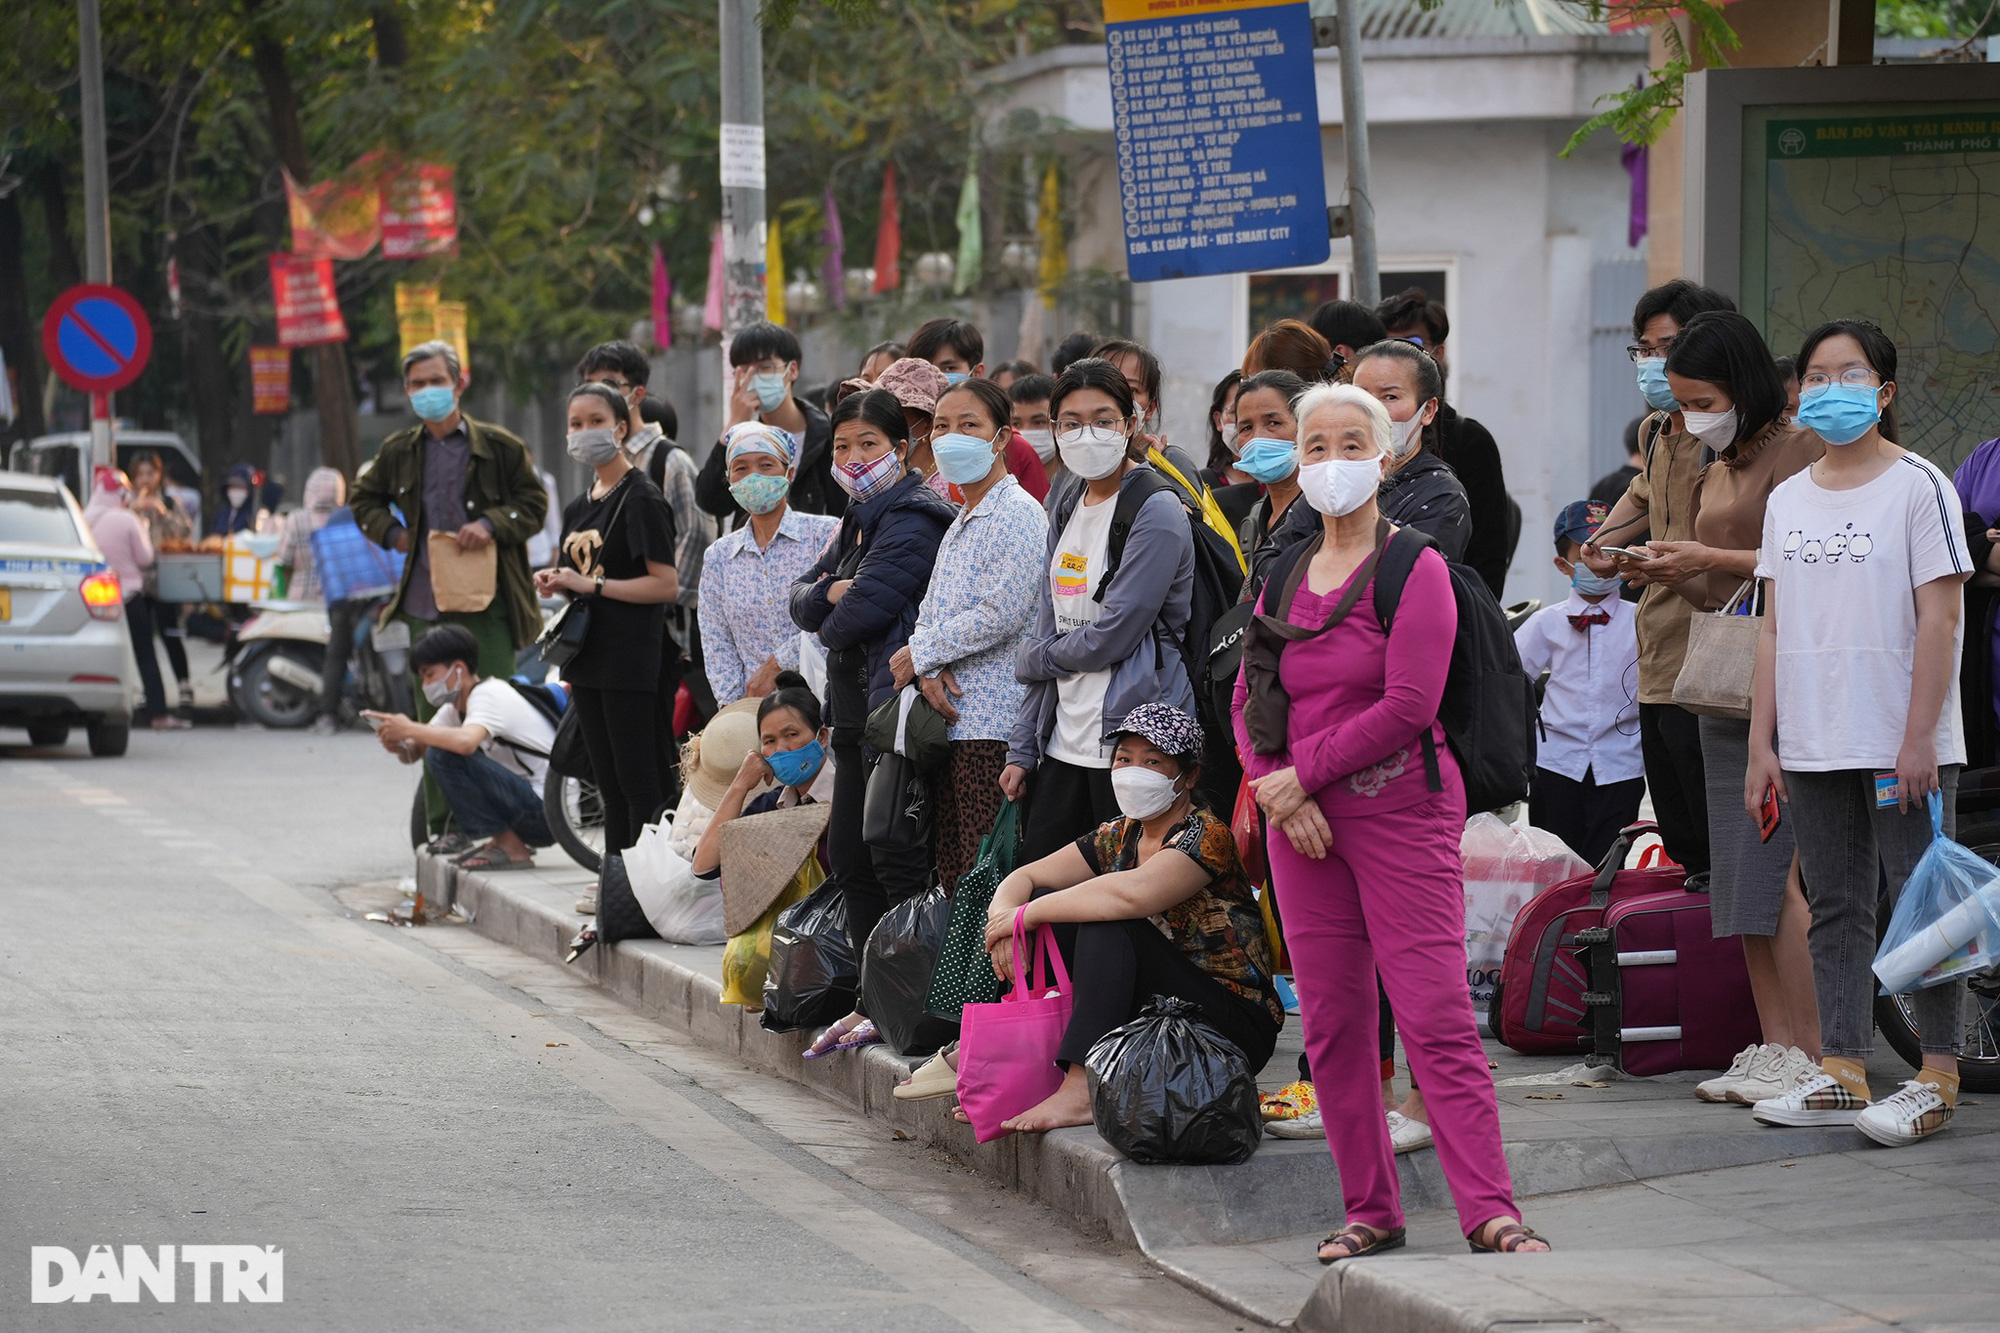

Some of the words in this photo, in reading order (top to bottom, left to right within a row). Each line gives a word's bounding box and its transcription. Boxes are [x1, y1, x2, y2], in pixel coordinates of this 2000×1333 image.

[1124, 30, 1135, 42] BX
[1137, 28, 1152, 40] GIA
[1180, 24, 1192, 36] BX
[1194, 21, 1212, 34] YÊN
[1214, 35, 1227, 47] BX
[1229, 32, 1247, 45] YÊN
[1127, 72, 1140, 83] BX
[1142, 69, 1164, 82] GIÁP
[1191, 65, 1204, 77] BX
[1206, 62, 1224, 75] YÊN
[1129, 86, 1142, 98] BX
[1130, 100, 1143, 111] BX
[1145, 96, 1167, 110] GIÁP
[1131, 112, 1153, 125] NAM
[1186, 107, 1211, 120] LONG
[1218, 105, 1231, 116] BX
[1233, 101, 1252, 114] YÊN
[1134, 141, 1147, 153] CV
[1135, 155, 1148, 167] SB
[1136, 169, 1149, 180] BX
[1138, 182, 1150, 194] CV
[1139, 196, 1152, 208] BX
[1151, 240, 1165, 252] BX
[1166, 236, 1188, 250] GIÁP
[1235, 229, 1267, 243] SMART
[1269, 227, 1289, 240] CITY
